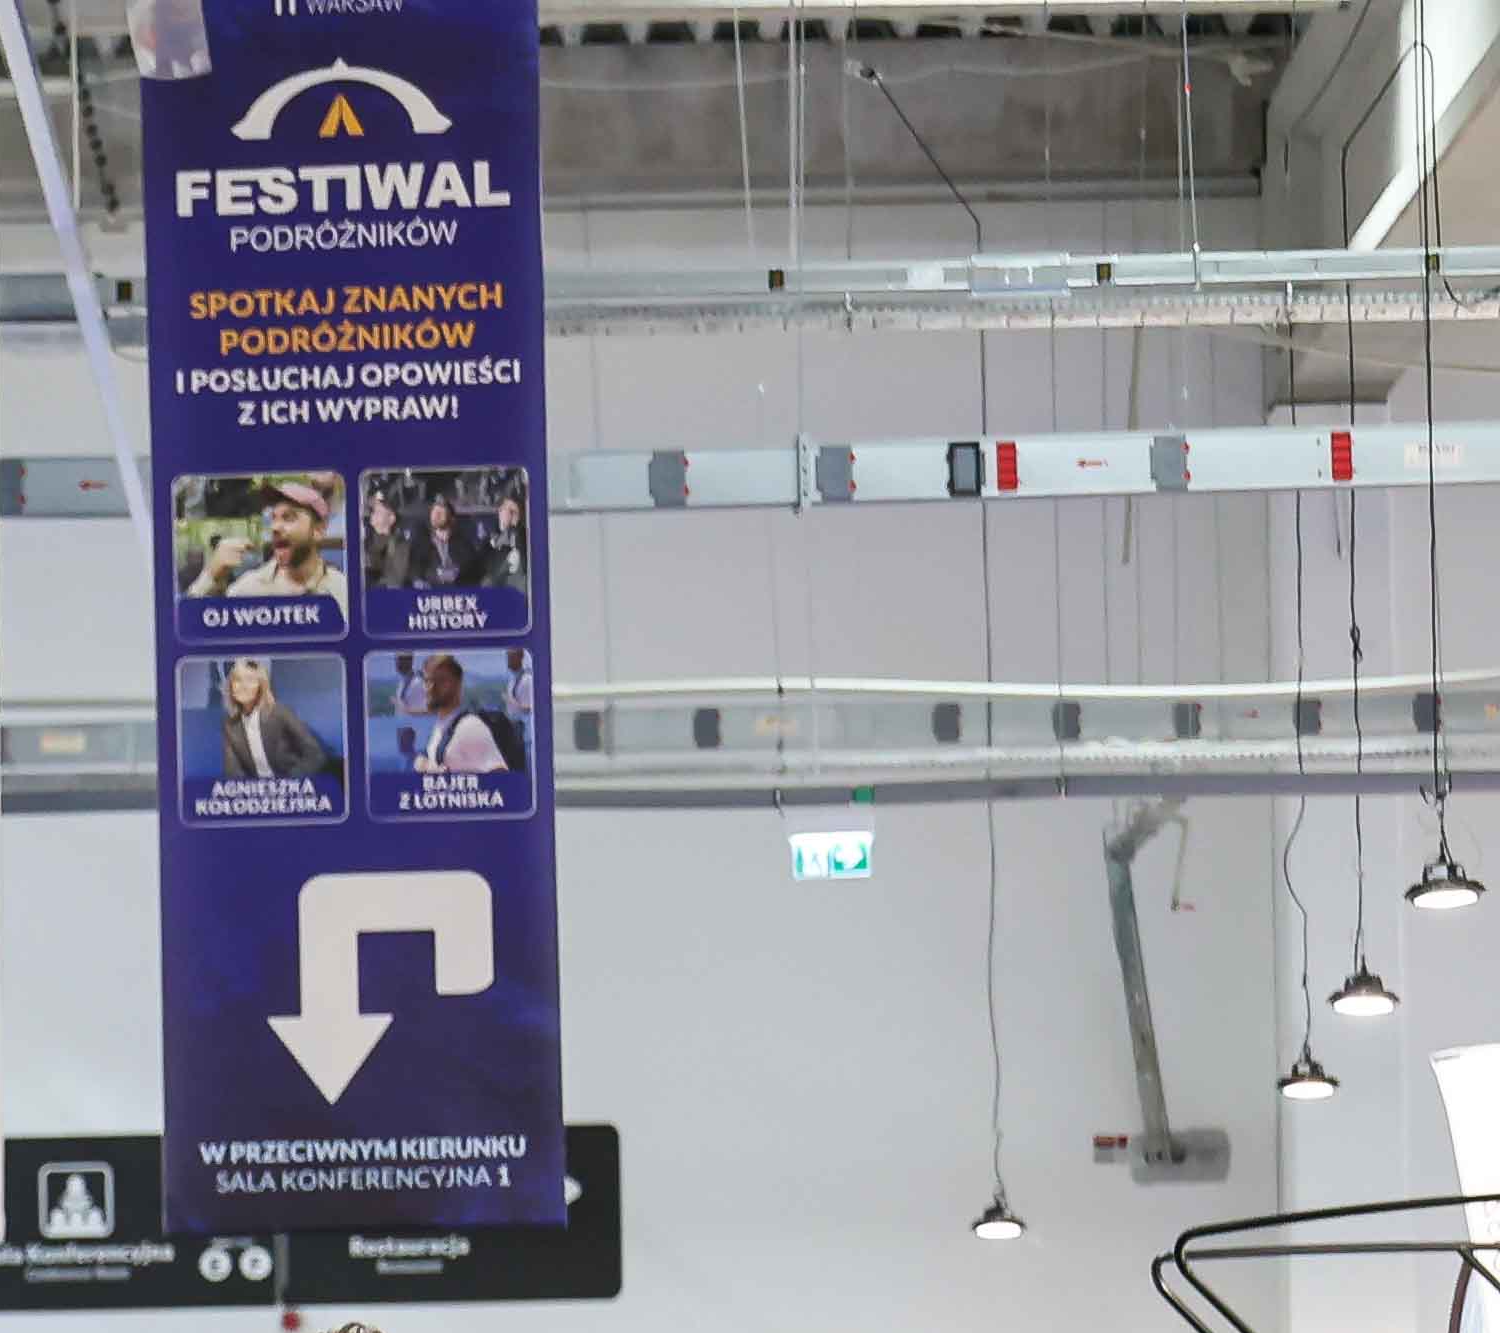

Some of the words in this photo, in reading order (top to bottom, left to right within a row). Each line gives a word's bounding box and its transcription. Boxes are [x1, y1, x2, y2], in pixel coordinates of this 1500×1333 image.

[176, 161, 511, 217] FESTIWAL
[230, 216, 458, 253] PODRÓŻNIKÓW
[189, 287, 335, 320] SPOTKAJ
[343, 283, 503, 315] ZNANYCH
[219, 319, 476, 357] PODRÓŻNIKÓW
[176, 370, 185, 394] I
[190, 363, 355, 394] POSŁUCHAJ
[360, 355, 521, 387] OPOWIEŚCI
[238, 402, 257, 426] Z
[262, 400, 309, 424] ICH
[315, 395, 459, 423] WYPRAW!
[199, 1143, 226, 1166] W
[229, 1138, 397, 1165] PRZECIWNYM
[400, 1135, 527, 1161] KIERUNKU
[215, 1170, 276, 1194] SALA
[282, 1166, 491, 1193] KONFERENCYJNA
[496, 1166, 510, 1187] 1
